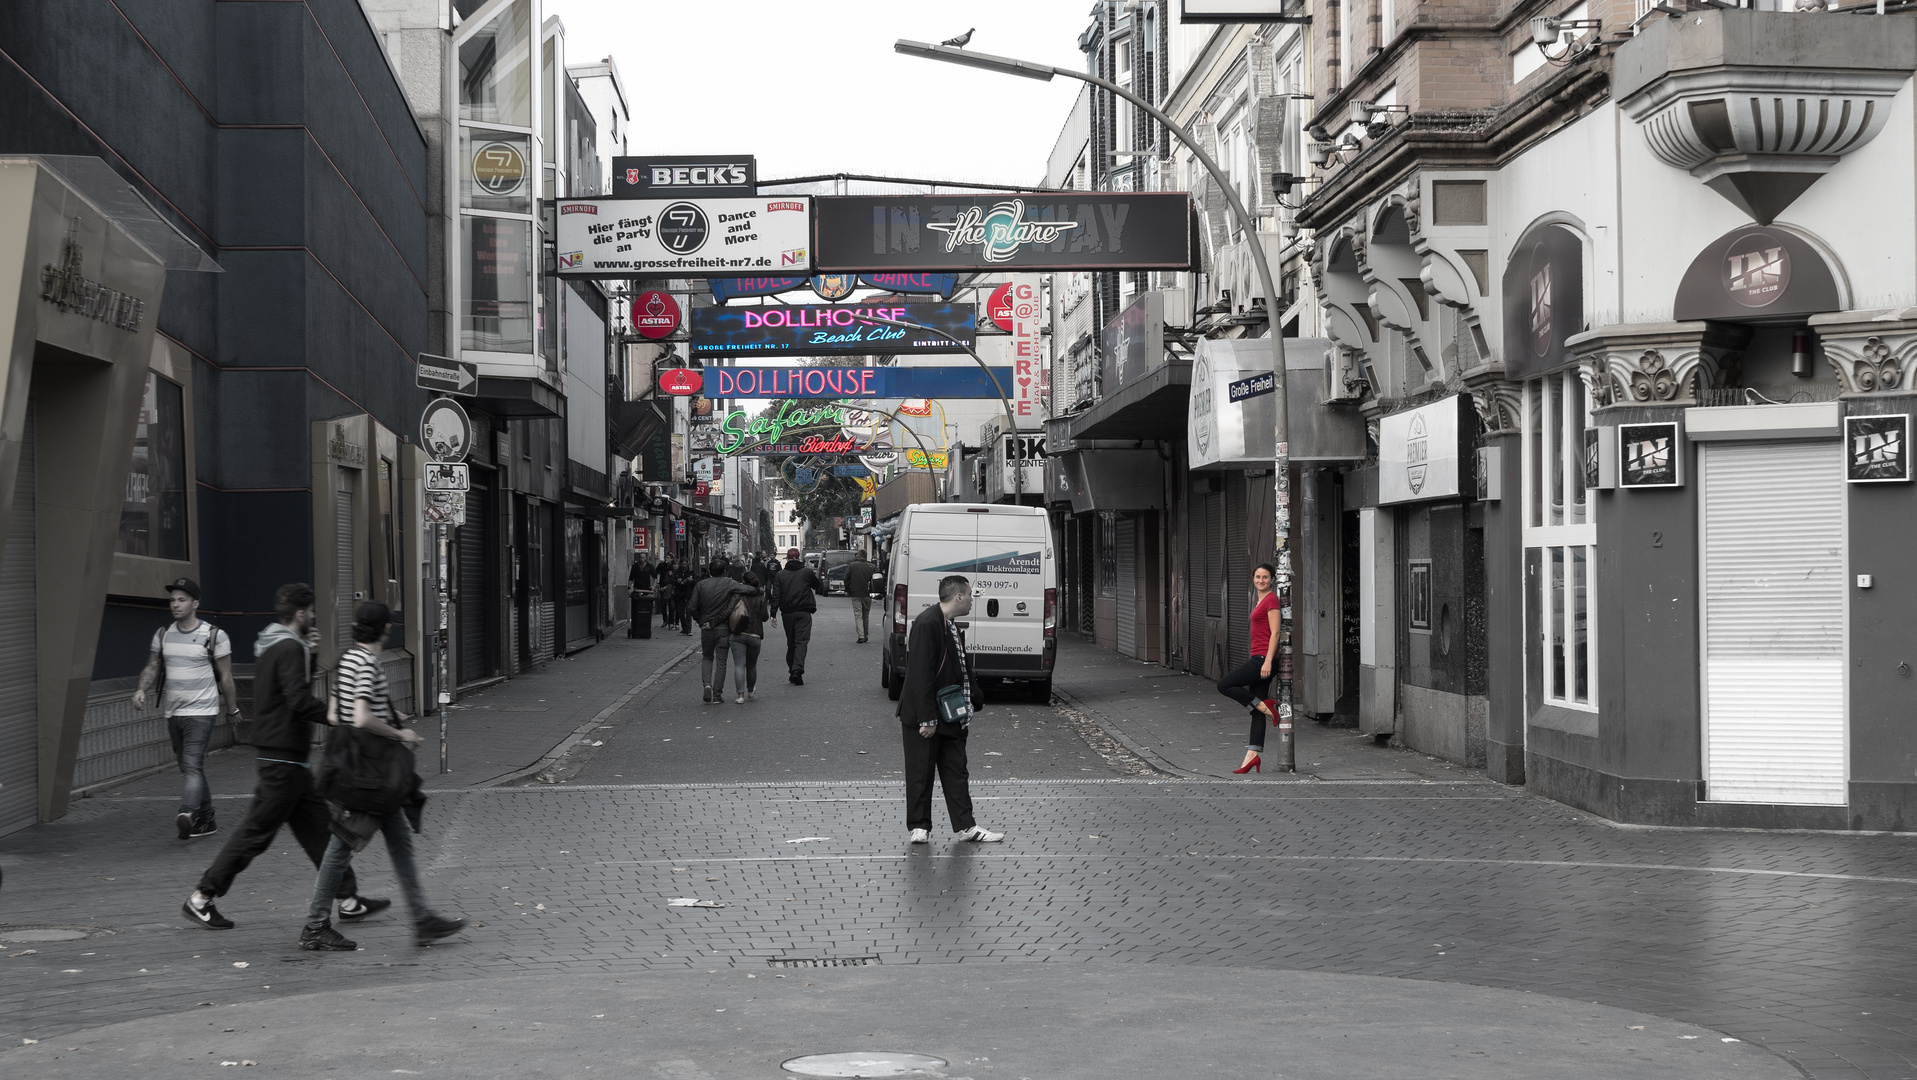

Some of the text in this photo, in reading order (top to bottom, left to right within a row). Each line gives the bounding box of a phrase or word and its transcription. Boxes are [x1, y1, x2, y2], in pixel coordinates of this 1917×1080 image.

[652, 165, 747, 185] BECK'S
[562, 206, 597, 215] SMIRNOFF
[718, 209, 757, 223] Dance
[768, 202, 803, 212] SMIRNOFF
[588, 215, 653, 235] Hier fängt
[727, 221, 751, 234] and
[983, 199, 1059, 262] plane
[593, 228, 651, 246] die Party
[724, 233, 758, 246] More
[616, 243, 632, 253] an
[594, 256, 772, 270] www.grossefreiheit-nr7.de
[1727, 247, 1784, 291] IN
[1530, 262, 1551, 333] IN
[1762, 285, 1778, 293] CLUB
[641, 317, 671, 325] ASTRA
[997, 309, 1014, 317] AST
[808, 325, 906, 344] Beach Club
[420, 366, 460, 381] Einbahnstraße
[719, 369, 876, 395] DOLLHOUSE
[1230, 374, 1273, 399] Große Freiheit
[716, 398, 850, 454] Safari
[799, 434, 857, 456] Bierdorf
[1005, 439, 1048, 460] BK
[1627, 437, 1670, 471] IN
[1854, 430, 1900, 465] IN
[910, 450, 945, 468] Safari
[1652, 530, 1663, 548] 2
[986, 564, 1040, 574] Elektroanlagen
[1008, 557, 1040, 566] Arendt
[977, 580, 992, 588] 839
[994, 580, 1019, 589] 097-0
[965, 644, 1033, 653] elektroanlagen.de
